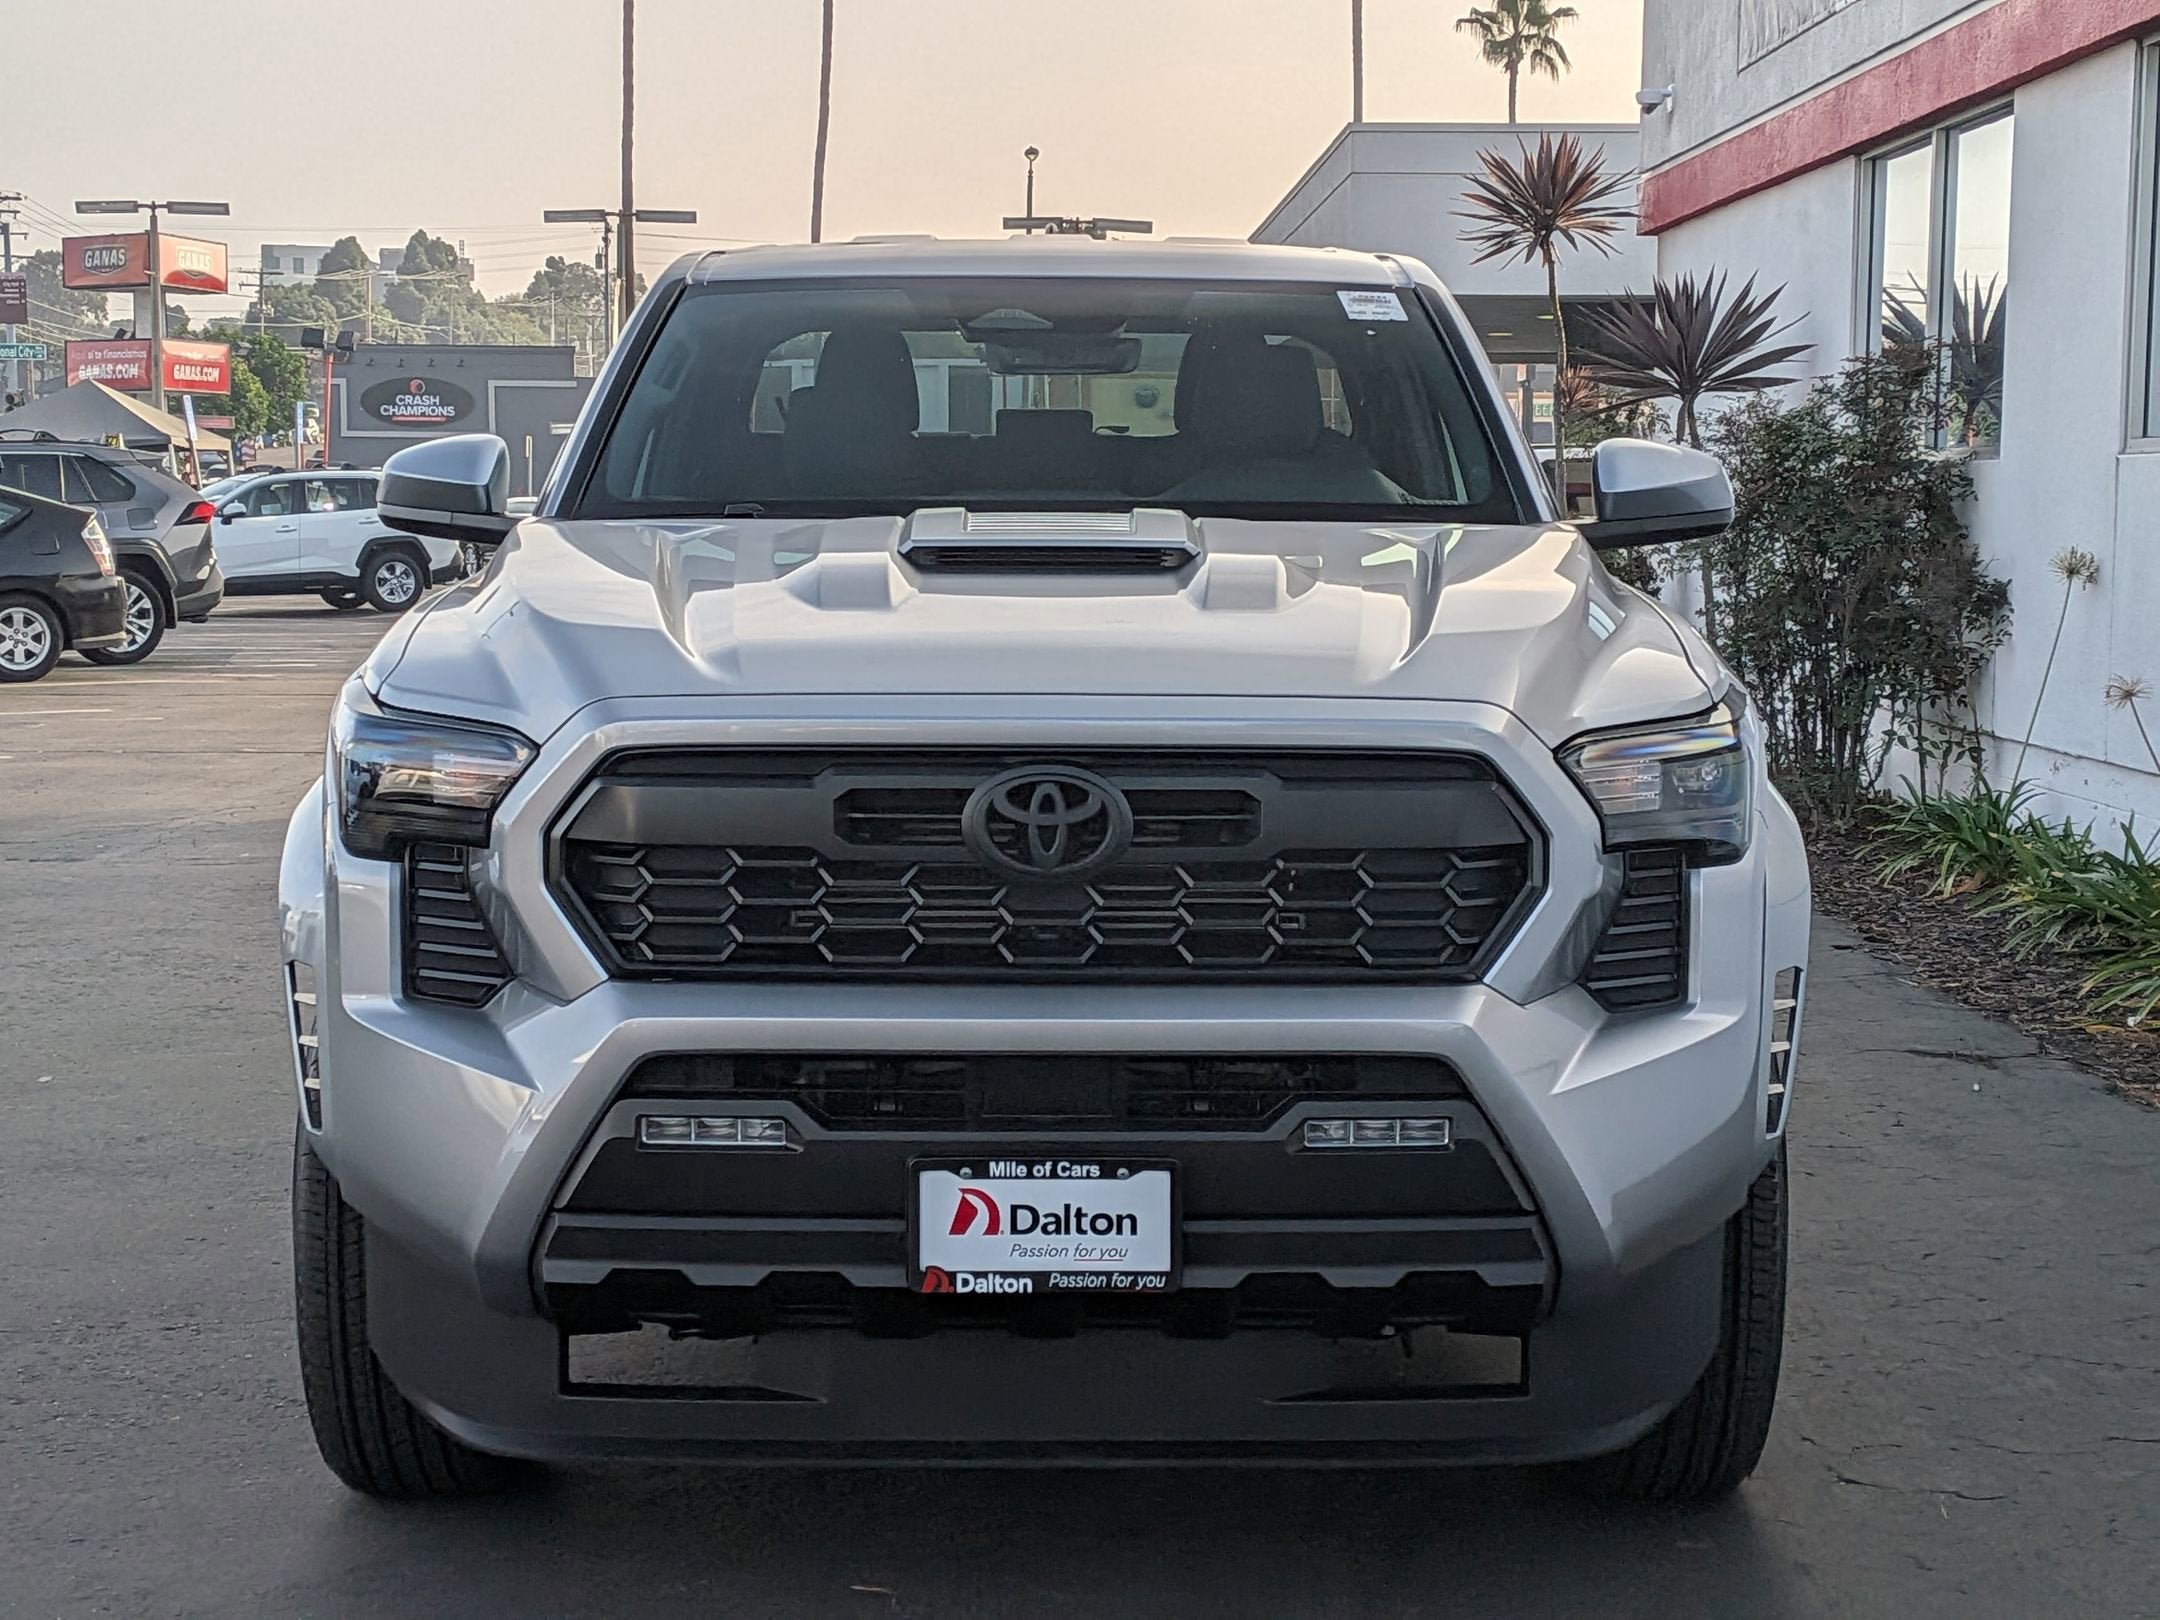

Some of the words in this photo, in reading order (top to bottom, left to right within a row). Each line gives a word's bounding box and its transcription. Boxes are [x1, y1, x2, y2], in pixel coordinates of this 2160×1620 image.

[84, 248, 126, 268] GANAS
[178, 250, 212, 269] GANAS
[79, 363, 139, 380] GANAS.COM
[173, 364, 220, 383] GANAS.COM
[395, 394, 440, 406] CRASH
[380, 404, 456, 417] CHAMPIONS
[989, 1161, 1028, 1178] Mile
[1032, 1161, 1053, 1178] of
[1056, 1161, 1101, 1178] Cars
[1009, 1203, 1138, 1236] Dalton
[1009, 1243, 1069, 1258] Passion
[1073, 1242, 1097, 1258] for
[1099, 1247, 1129, 1261] you
[956, 1272, 1033, 1294] Dalton
[1049, 1272, 1107, 1288] Passion
[1111, 1272, 1135, 1288] for
[1135, 1274, 1166, 1291] you
